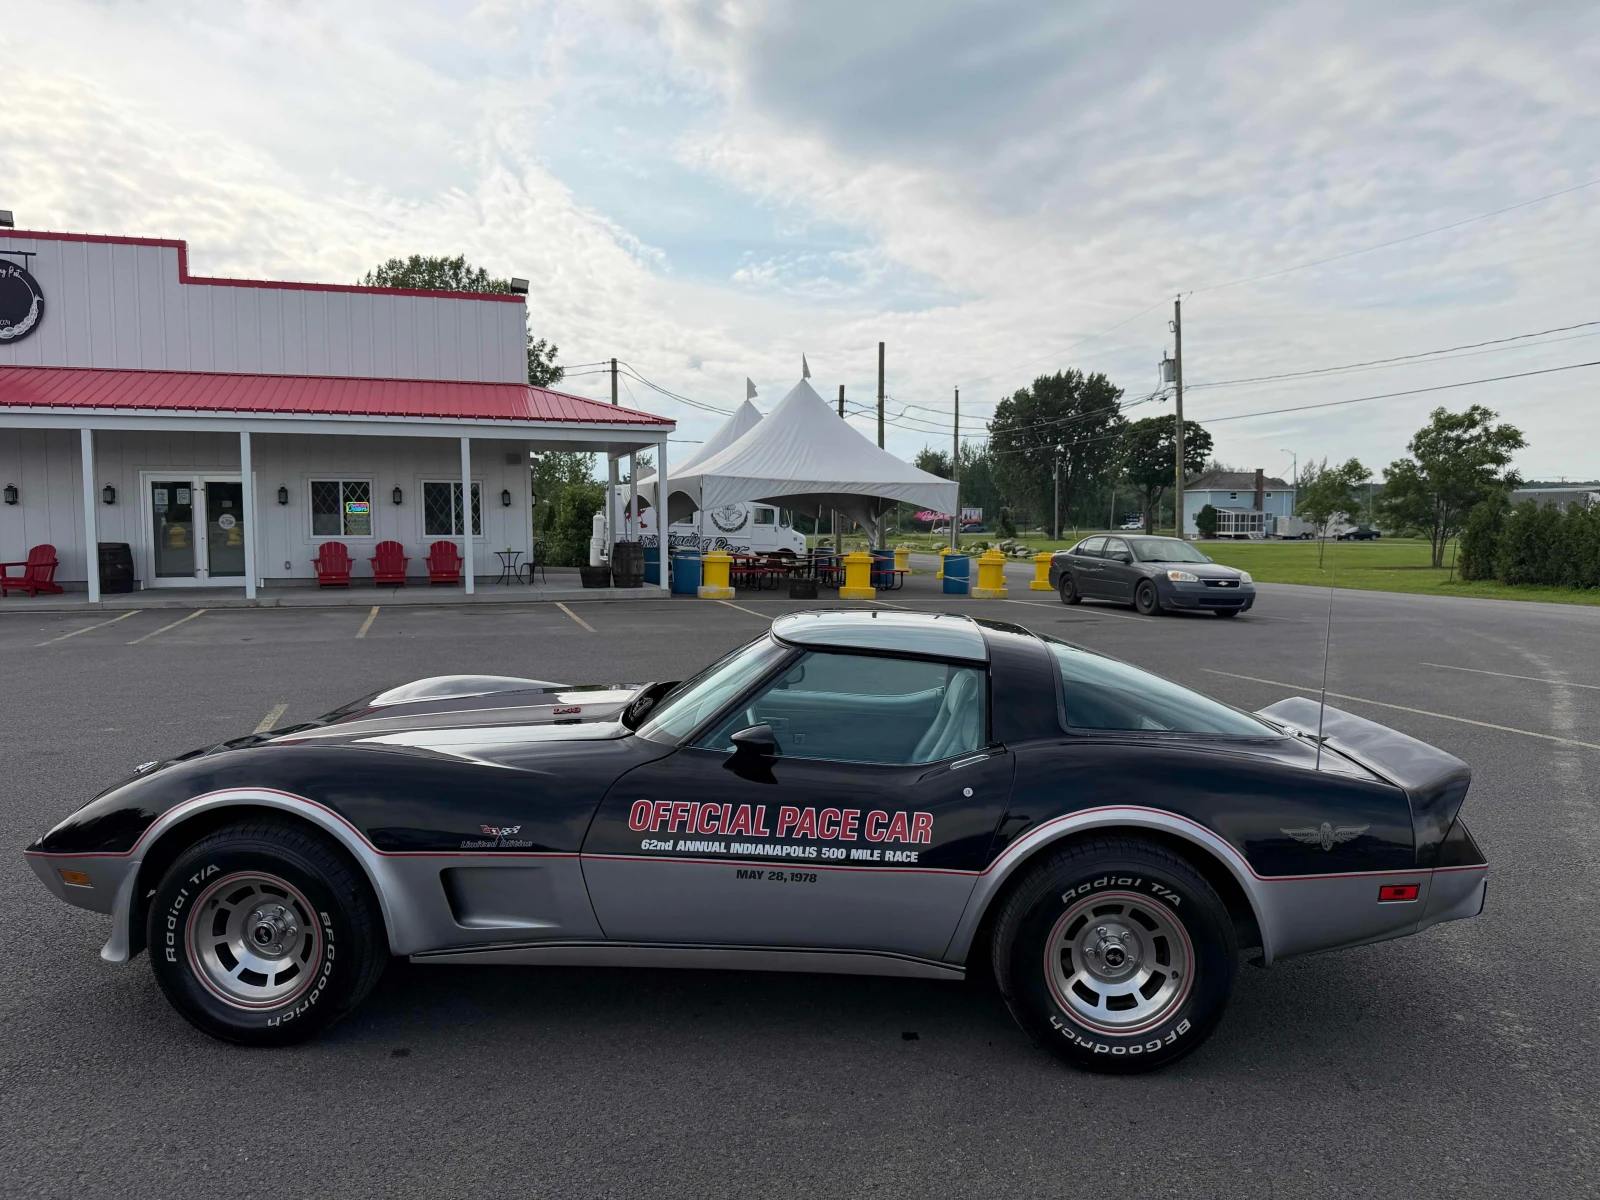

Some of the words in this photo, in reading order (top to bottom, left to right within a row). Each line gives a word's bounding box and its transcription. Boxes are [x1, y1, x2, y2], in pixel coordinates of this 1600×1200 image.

[628, 799, 770, 837] OFFICIAL
[776, 805, 860, 841] PACE
[865, 810, 934, 844] CAR
[641, 839, 674, 851] 62nd
[676, 840, 727, 853] ANNUAL
[729, 842, 817, 858] INDIANAPOLIS
[821, 847, 846, 860] 500
[850, 848, 881, 861] MILE
[884, 850, 919, 863] RACE
[735, 869, 765, 880] MAY
[767, 870, 788, 884] 28,
[790, 872, 818, 884] 1978
[1061, 875, 1142, 904] Radial
[1151, 882, 1182, 907] T/A
[165, 888, 189, 963] Radial
[189, 863, 221, 885] T/A
[267, 911, 335, 1027] BFGoodrich
[1050, 1015, 1192, 1055] BFGoodrich
